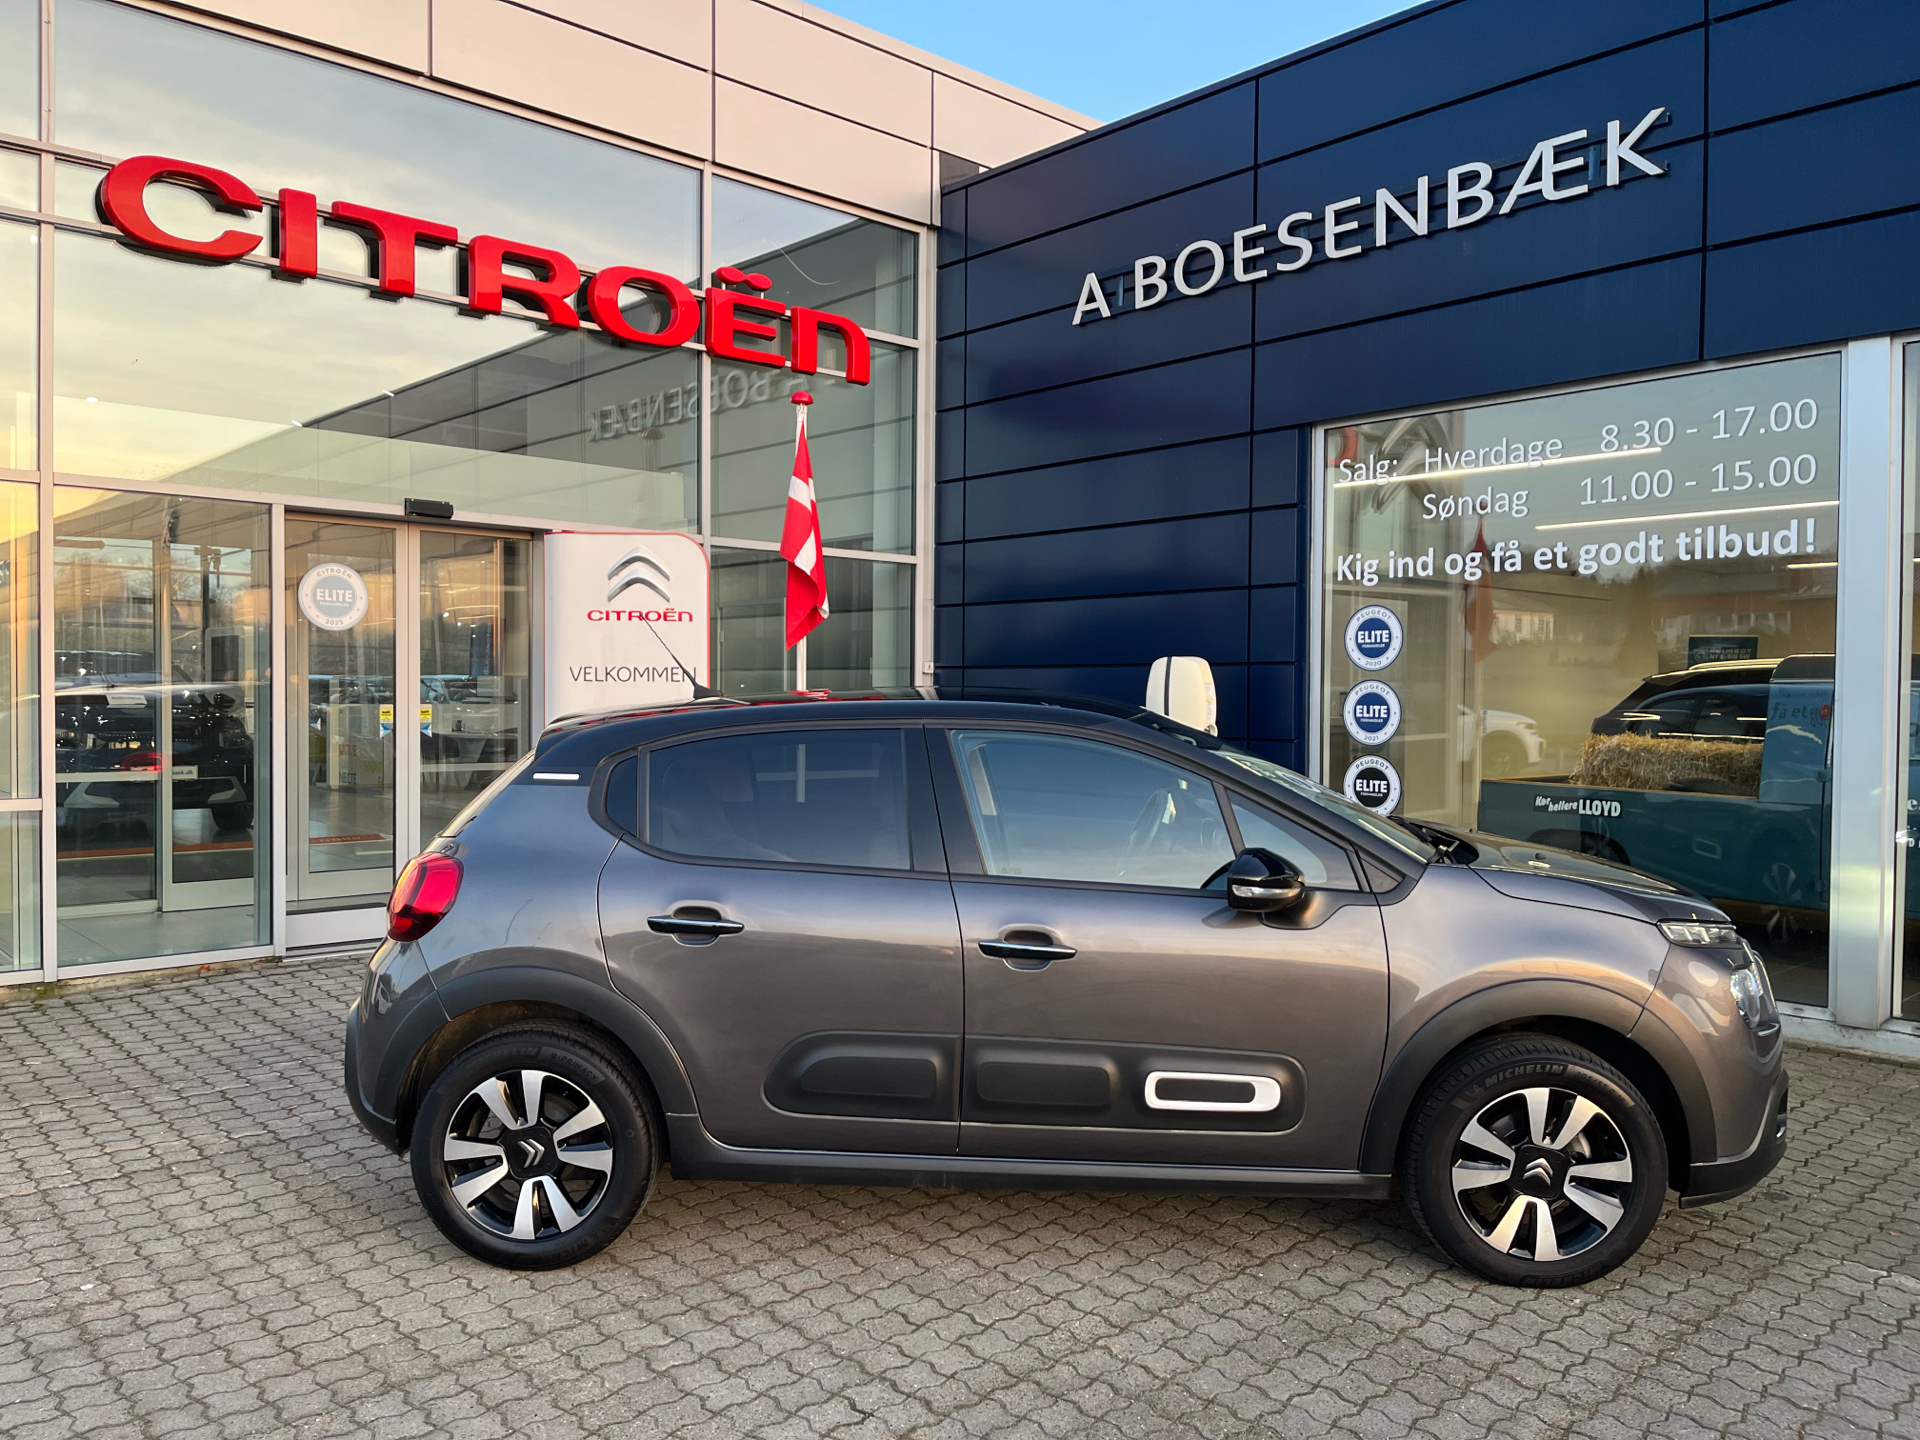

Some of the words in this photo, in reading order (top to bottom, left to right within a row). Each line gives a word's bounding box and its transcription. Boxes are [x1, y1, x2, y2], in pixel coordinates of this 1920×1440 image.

[1072, 272, 1111, 325] A
[1134, 107, 1667, 309] BOESENBÆK
[1338, 454, 1398, 485] Salg:
[1425, 437, 1563, 473] Hverdage
[1600, 417, 1675, 453] 8.30
[1712, 398, 1818, 440] 17.00
[1422, 486, 1529, 521] Søndag
[1580, 469, 1674, 506] 11.00
[1711, 454, 1817, 493] 15.00
[1337, 553, 1380, 587] Kig
[1389, 547, 1434, 578] ind
[1445, 552, 1483, 581] og
[1491, 540, 1522, 572] få
[1533, 541, 1569, 570] et
[1578, 531, 1664, 575] godt
[1676, 518, 1816, 561] tilbud!
[316, 588, 353, 602] ELITE
[1356, 609, 1392, 622] PEUGEOT
[1357, 630, 1390, 644] ELITE
[569, 666, 697, 682] VELKOMMEN
[1354, 684, 1390, 696] PEUGEOT
[1355, 705, 1388, 718] ELITE
[1355, 758, 1390, 771] PEUGEOT
[1355, 779, 1388, 793] ELITE
[1548, 800, 1578, 812] hellere
[1578, 799, 1622, 817] LLOYD
[1485, 1064, 1564, 1088] MICHELIN
